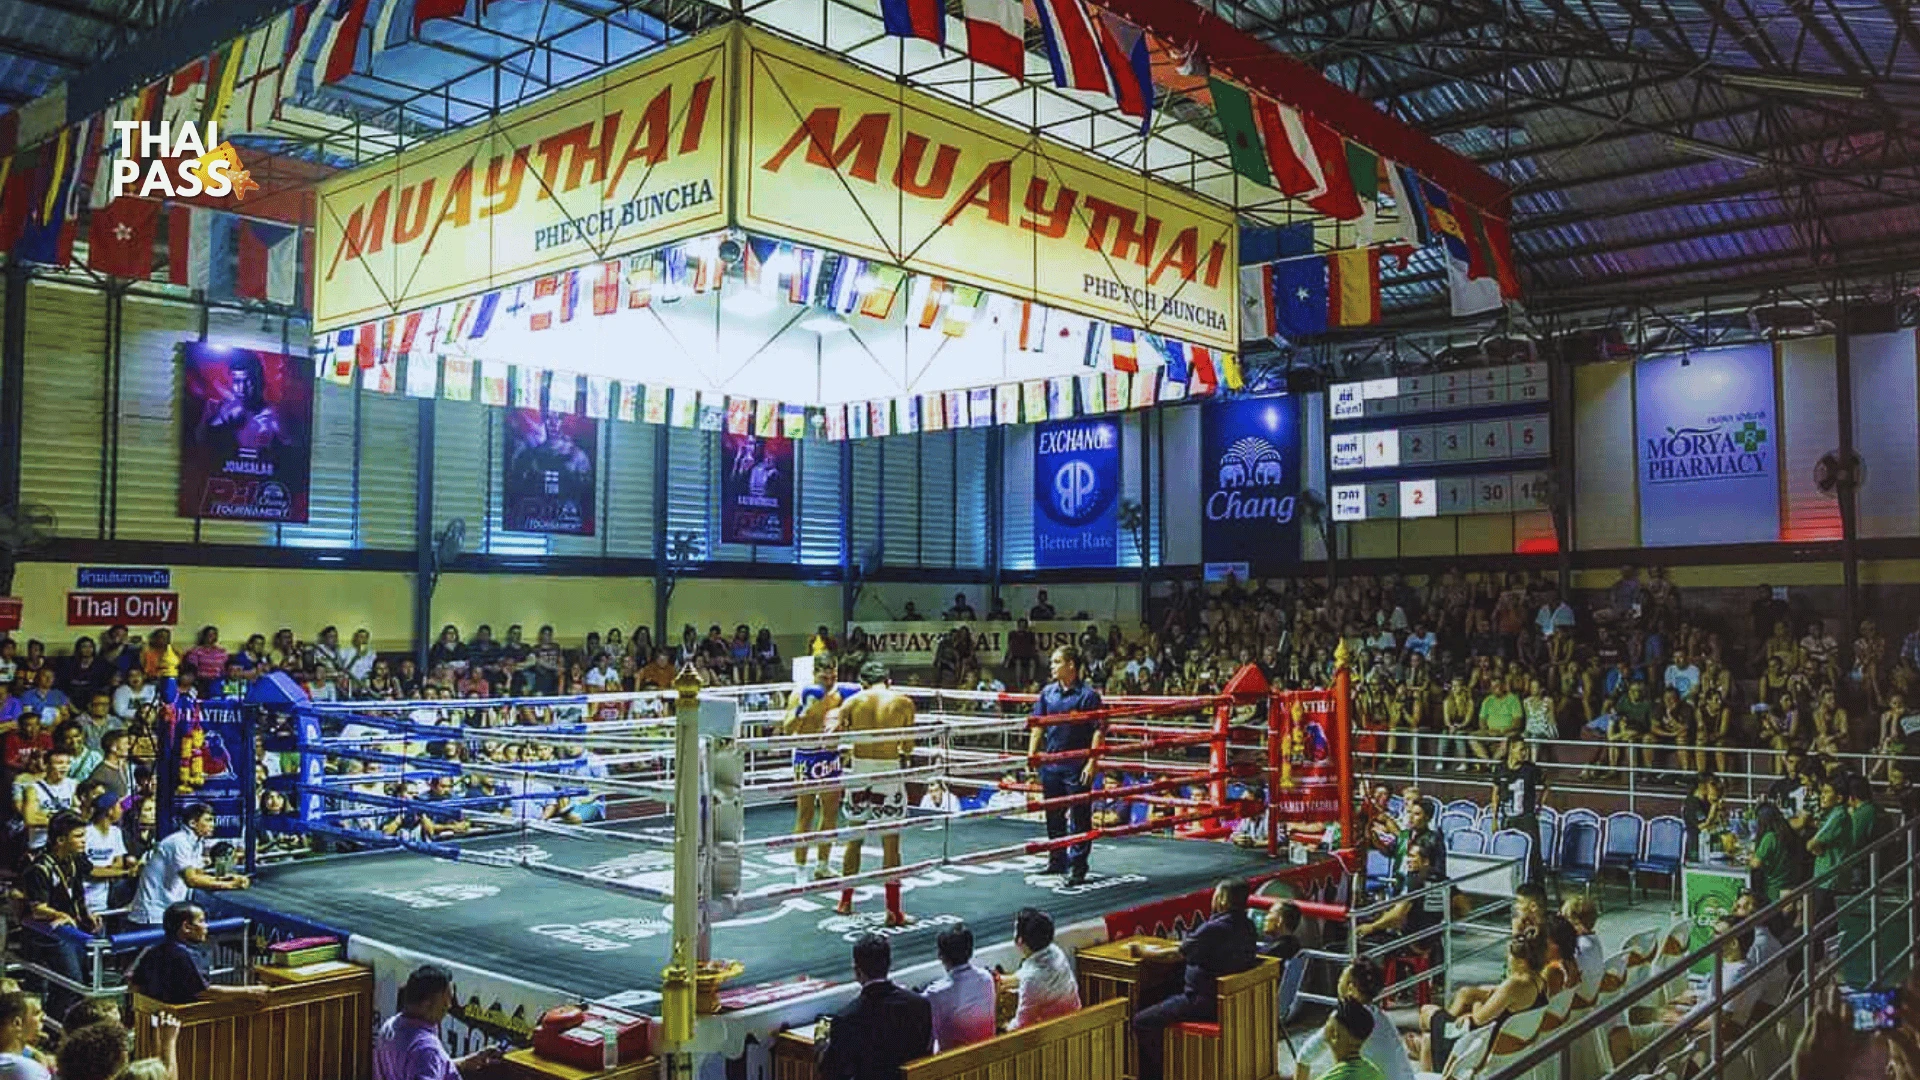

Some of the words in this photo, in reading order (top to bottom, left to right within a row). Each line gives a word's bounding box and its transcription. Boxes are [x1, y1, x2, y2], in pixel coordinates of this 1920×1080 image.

[326, 76, 714, 282] MUAYTHAI
[761, 106, 1227, 289] MUAYTHAI
[534, 209, 616, 252] PHETCH
[622, 178, 715, 226] BUNCHA
[1083, 274, 1158, 310] PHETCH
[1162, 296, 1228, 331] BUNCHA
[1376, 441, 1384, 457] 1
[1411, 437, 1422, 453] 2
[1447, 434, 1458, 450] 3
[1485, 431, 1496, 448] 4
[1647, 431, 1736, 459] MORYA
[1648, 453, 1764, 480] PHARMACY
[1206, 491, 1296, 524] Chang
[1337, 504, 1361, 515] Time
[1377, 492, 1388, 508] 3
[1413, 488, 1424, 505] 2
[1450, 486, 1458, 503] 1
[1482, 484, 1503, 501] 30
[1040, 534, 1079, 551] Better
[1082, 532, 1114, 549] Rate
[73, 595, 118, 617] Thai
[125, 595, 173, 621] Only
[868, 632, 1000, 652] MUAYAI
